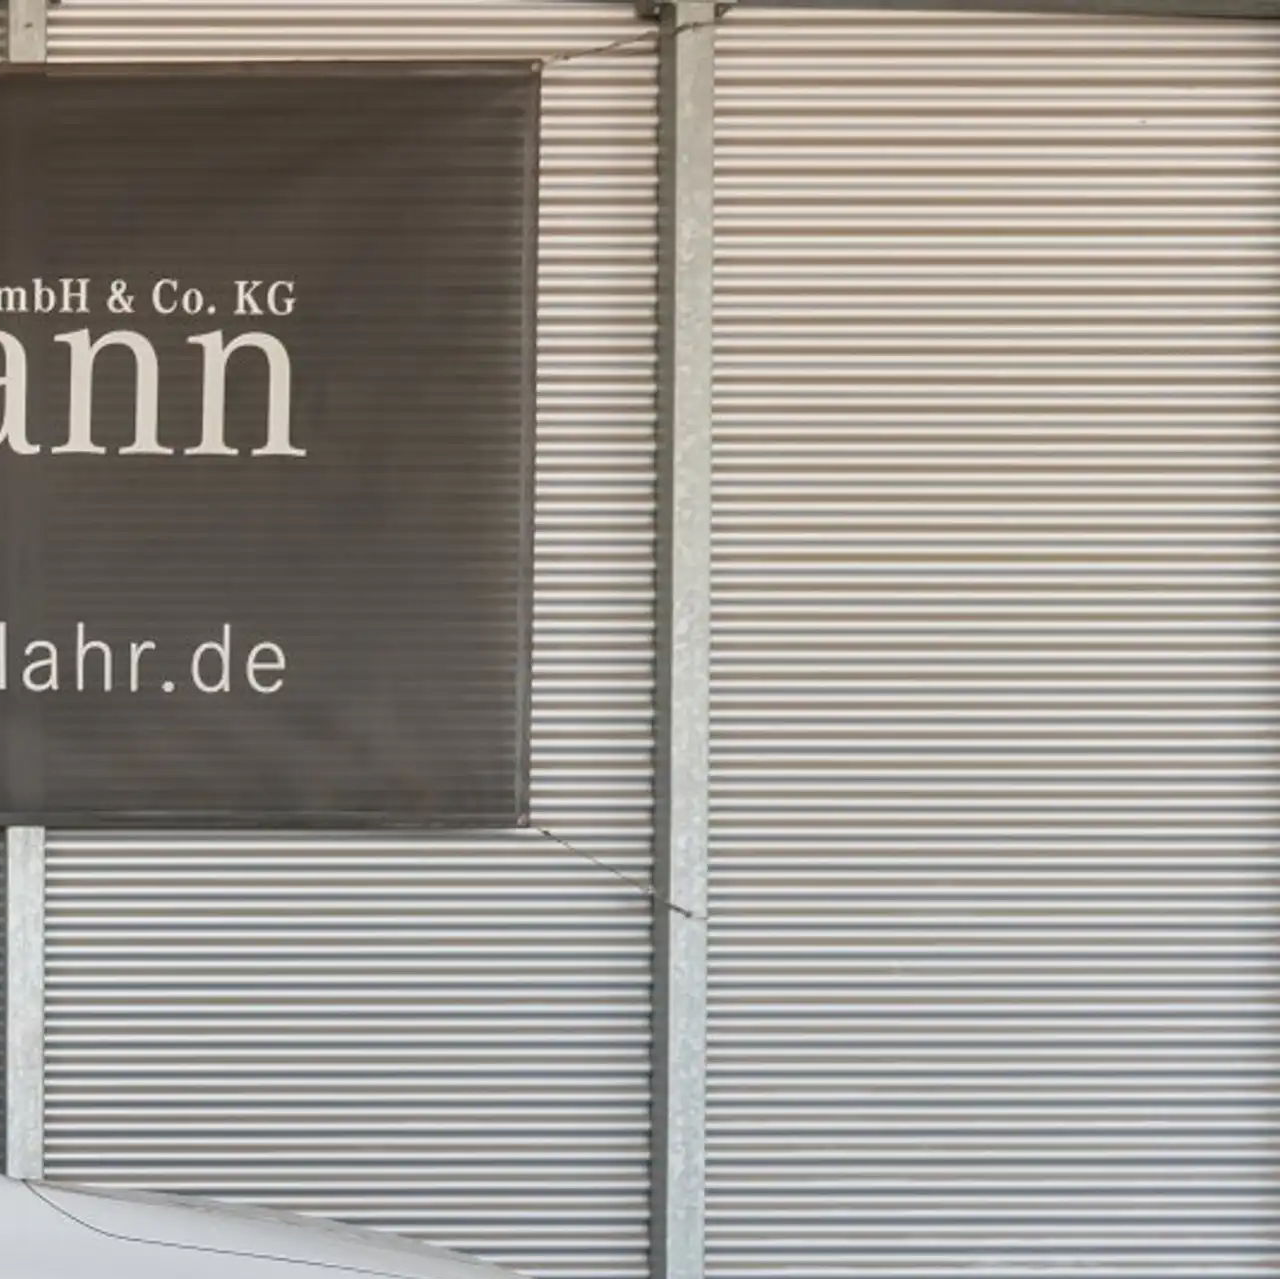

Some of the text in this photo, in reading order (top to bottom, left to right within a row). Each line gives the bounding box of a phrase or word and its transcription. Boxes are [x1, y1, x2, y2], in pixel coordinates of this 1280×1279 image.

[106, 279, 134, 314] &
[152, 278, 216, 315] Co.
[234, 280, 296, 316] KG
